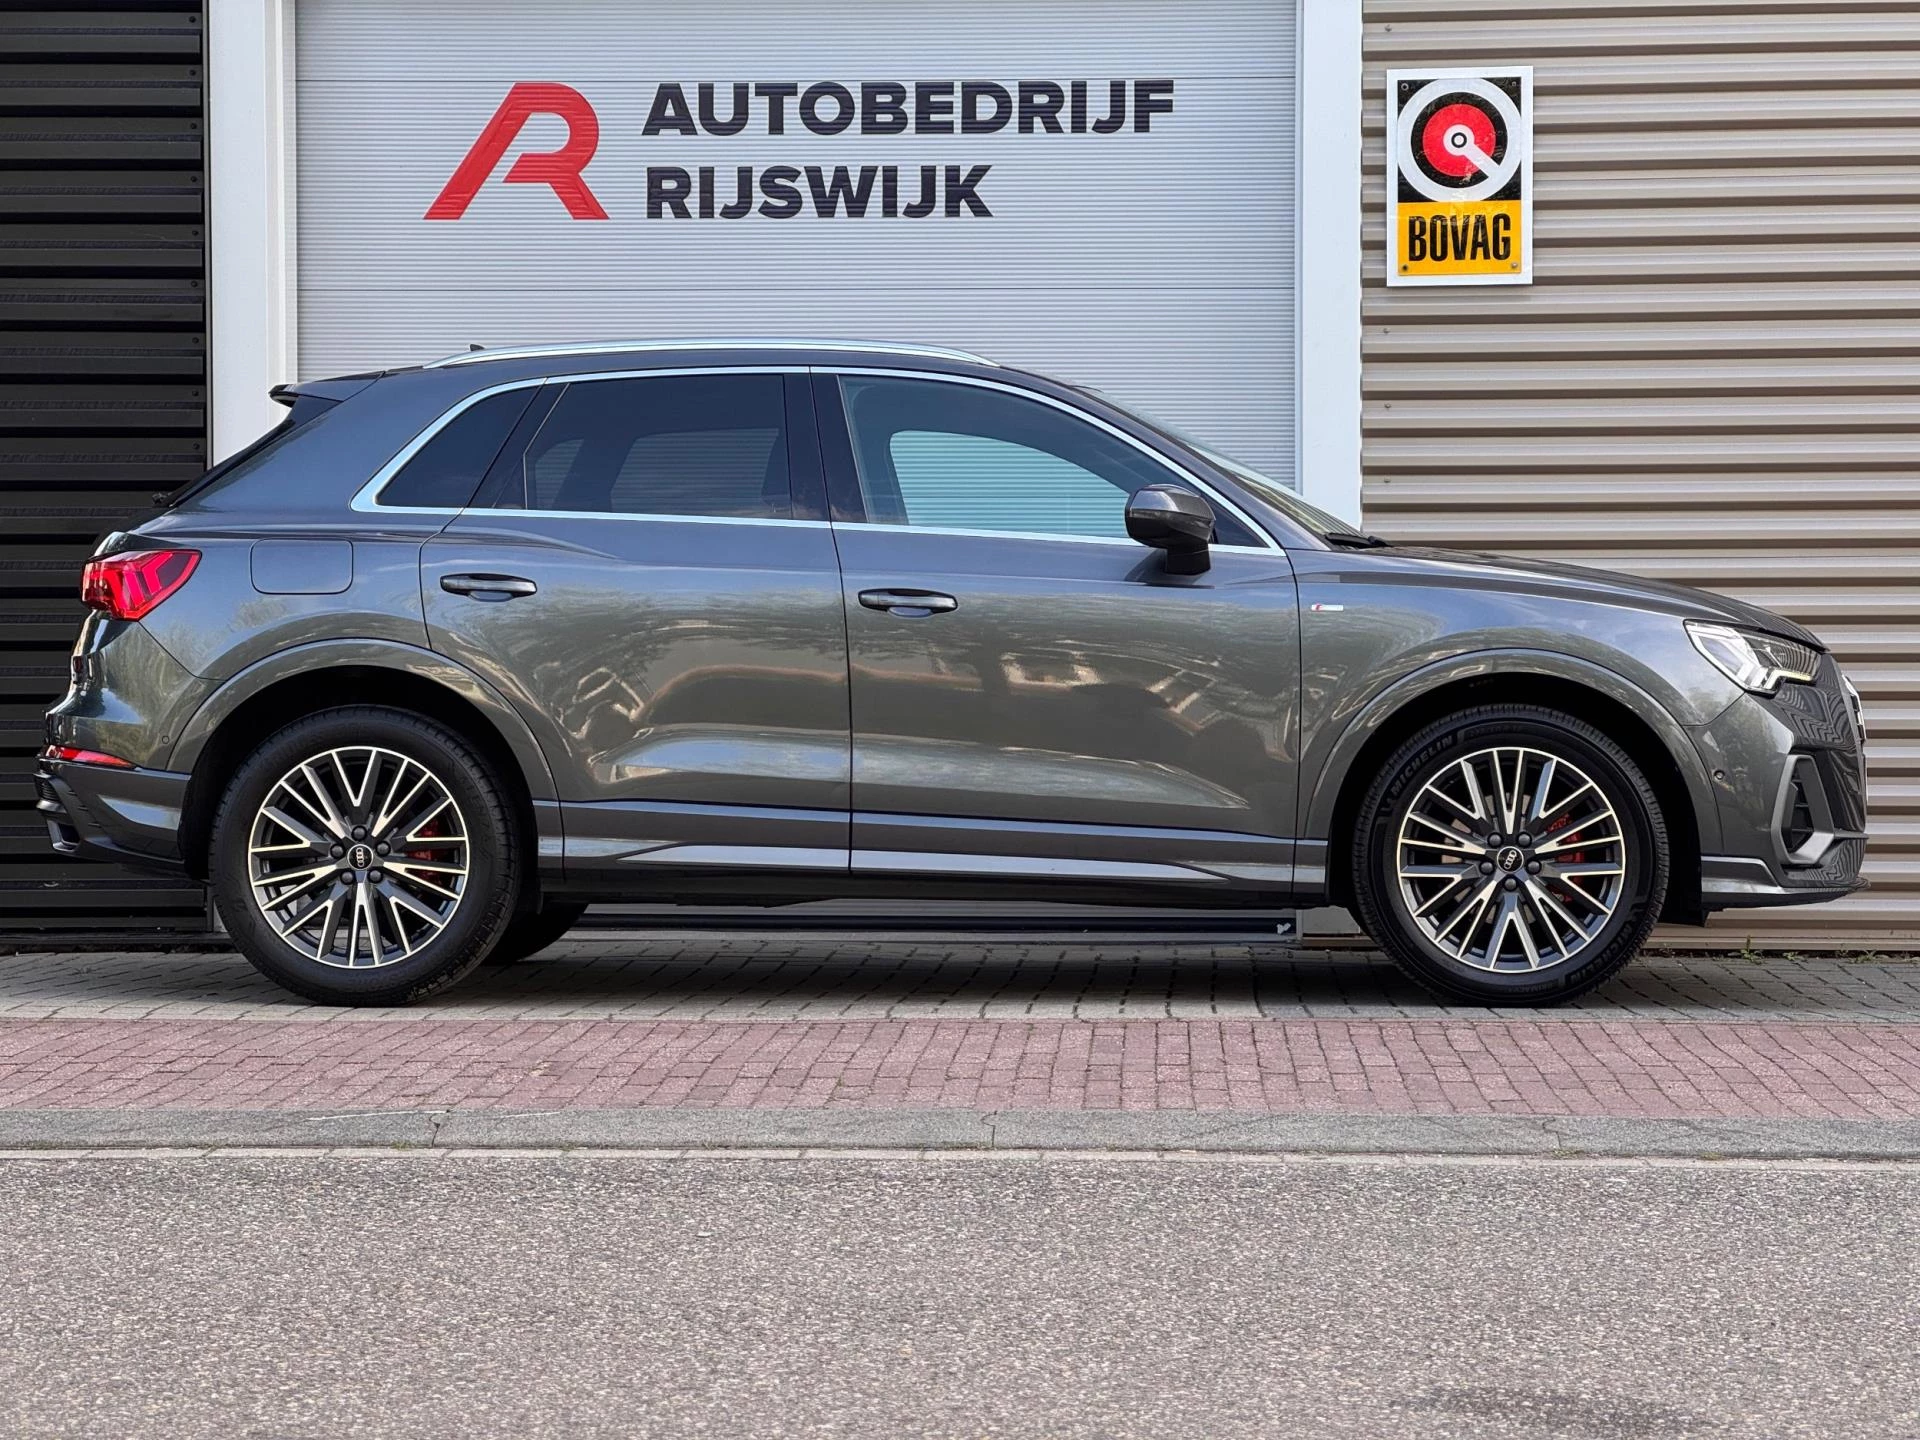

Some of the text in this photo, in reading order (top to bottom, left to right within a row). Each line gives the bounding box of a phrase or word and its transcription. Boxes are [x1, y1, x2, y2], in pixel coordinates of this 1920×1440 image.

[642, 80, 1174, 136] AUTOBEDRIJF
[646, 165, 992, 219] RIJSWIJK
[1408, 213, 1511, 262] BOVAG
[1391, 734, 1454, 797] MICHELIN
